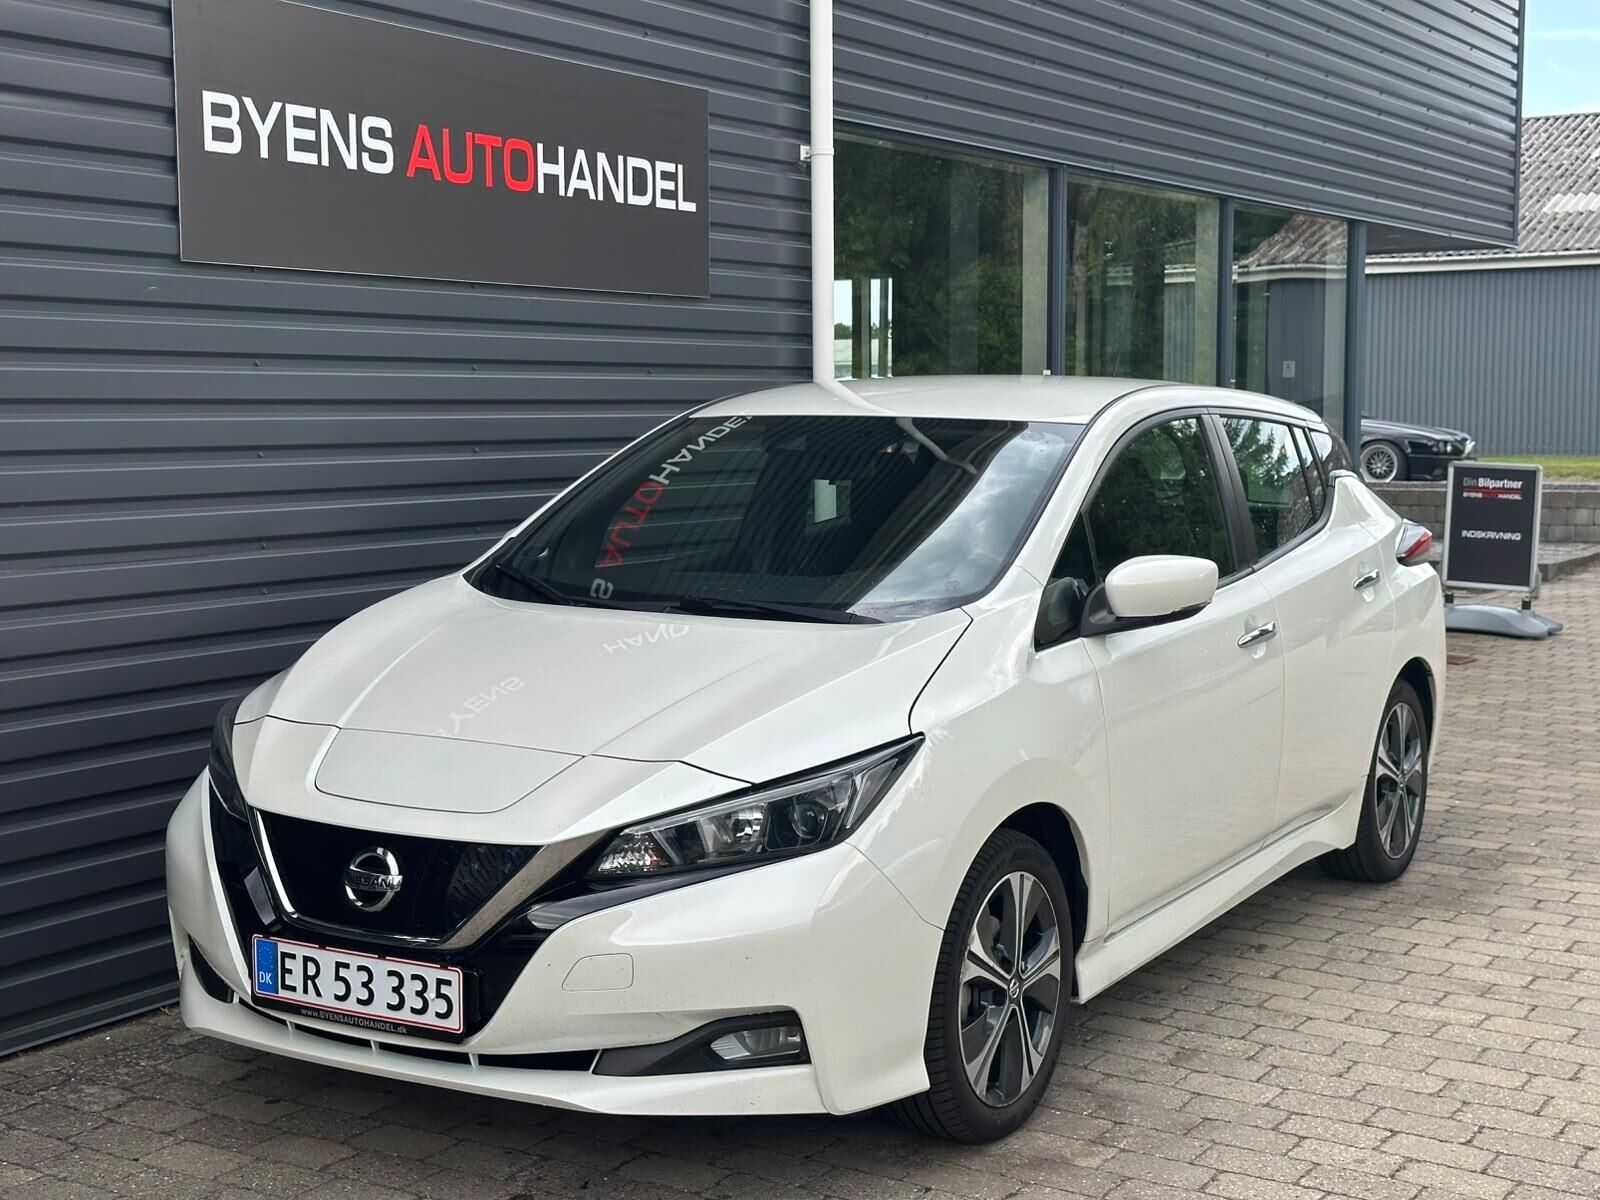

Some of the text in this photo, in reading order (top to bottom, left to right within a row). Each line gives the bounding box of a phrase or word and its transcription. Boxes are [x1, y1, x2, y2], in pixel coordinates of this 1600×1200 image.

[201, 89, 697, 213] BYENS AUTOHANDEL
[1463, 477, 1522, 489] Din Bilpartner
[1461, 530, 1521, 540] INDSKRIVNING
[259, 972, 272, 984] DK
[280, 951, 454, 1020] ER 53 335
[301, 1008, 407, 1034] www.BYENSAUTOHANDEL.dk
